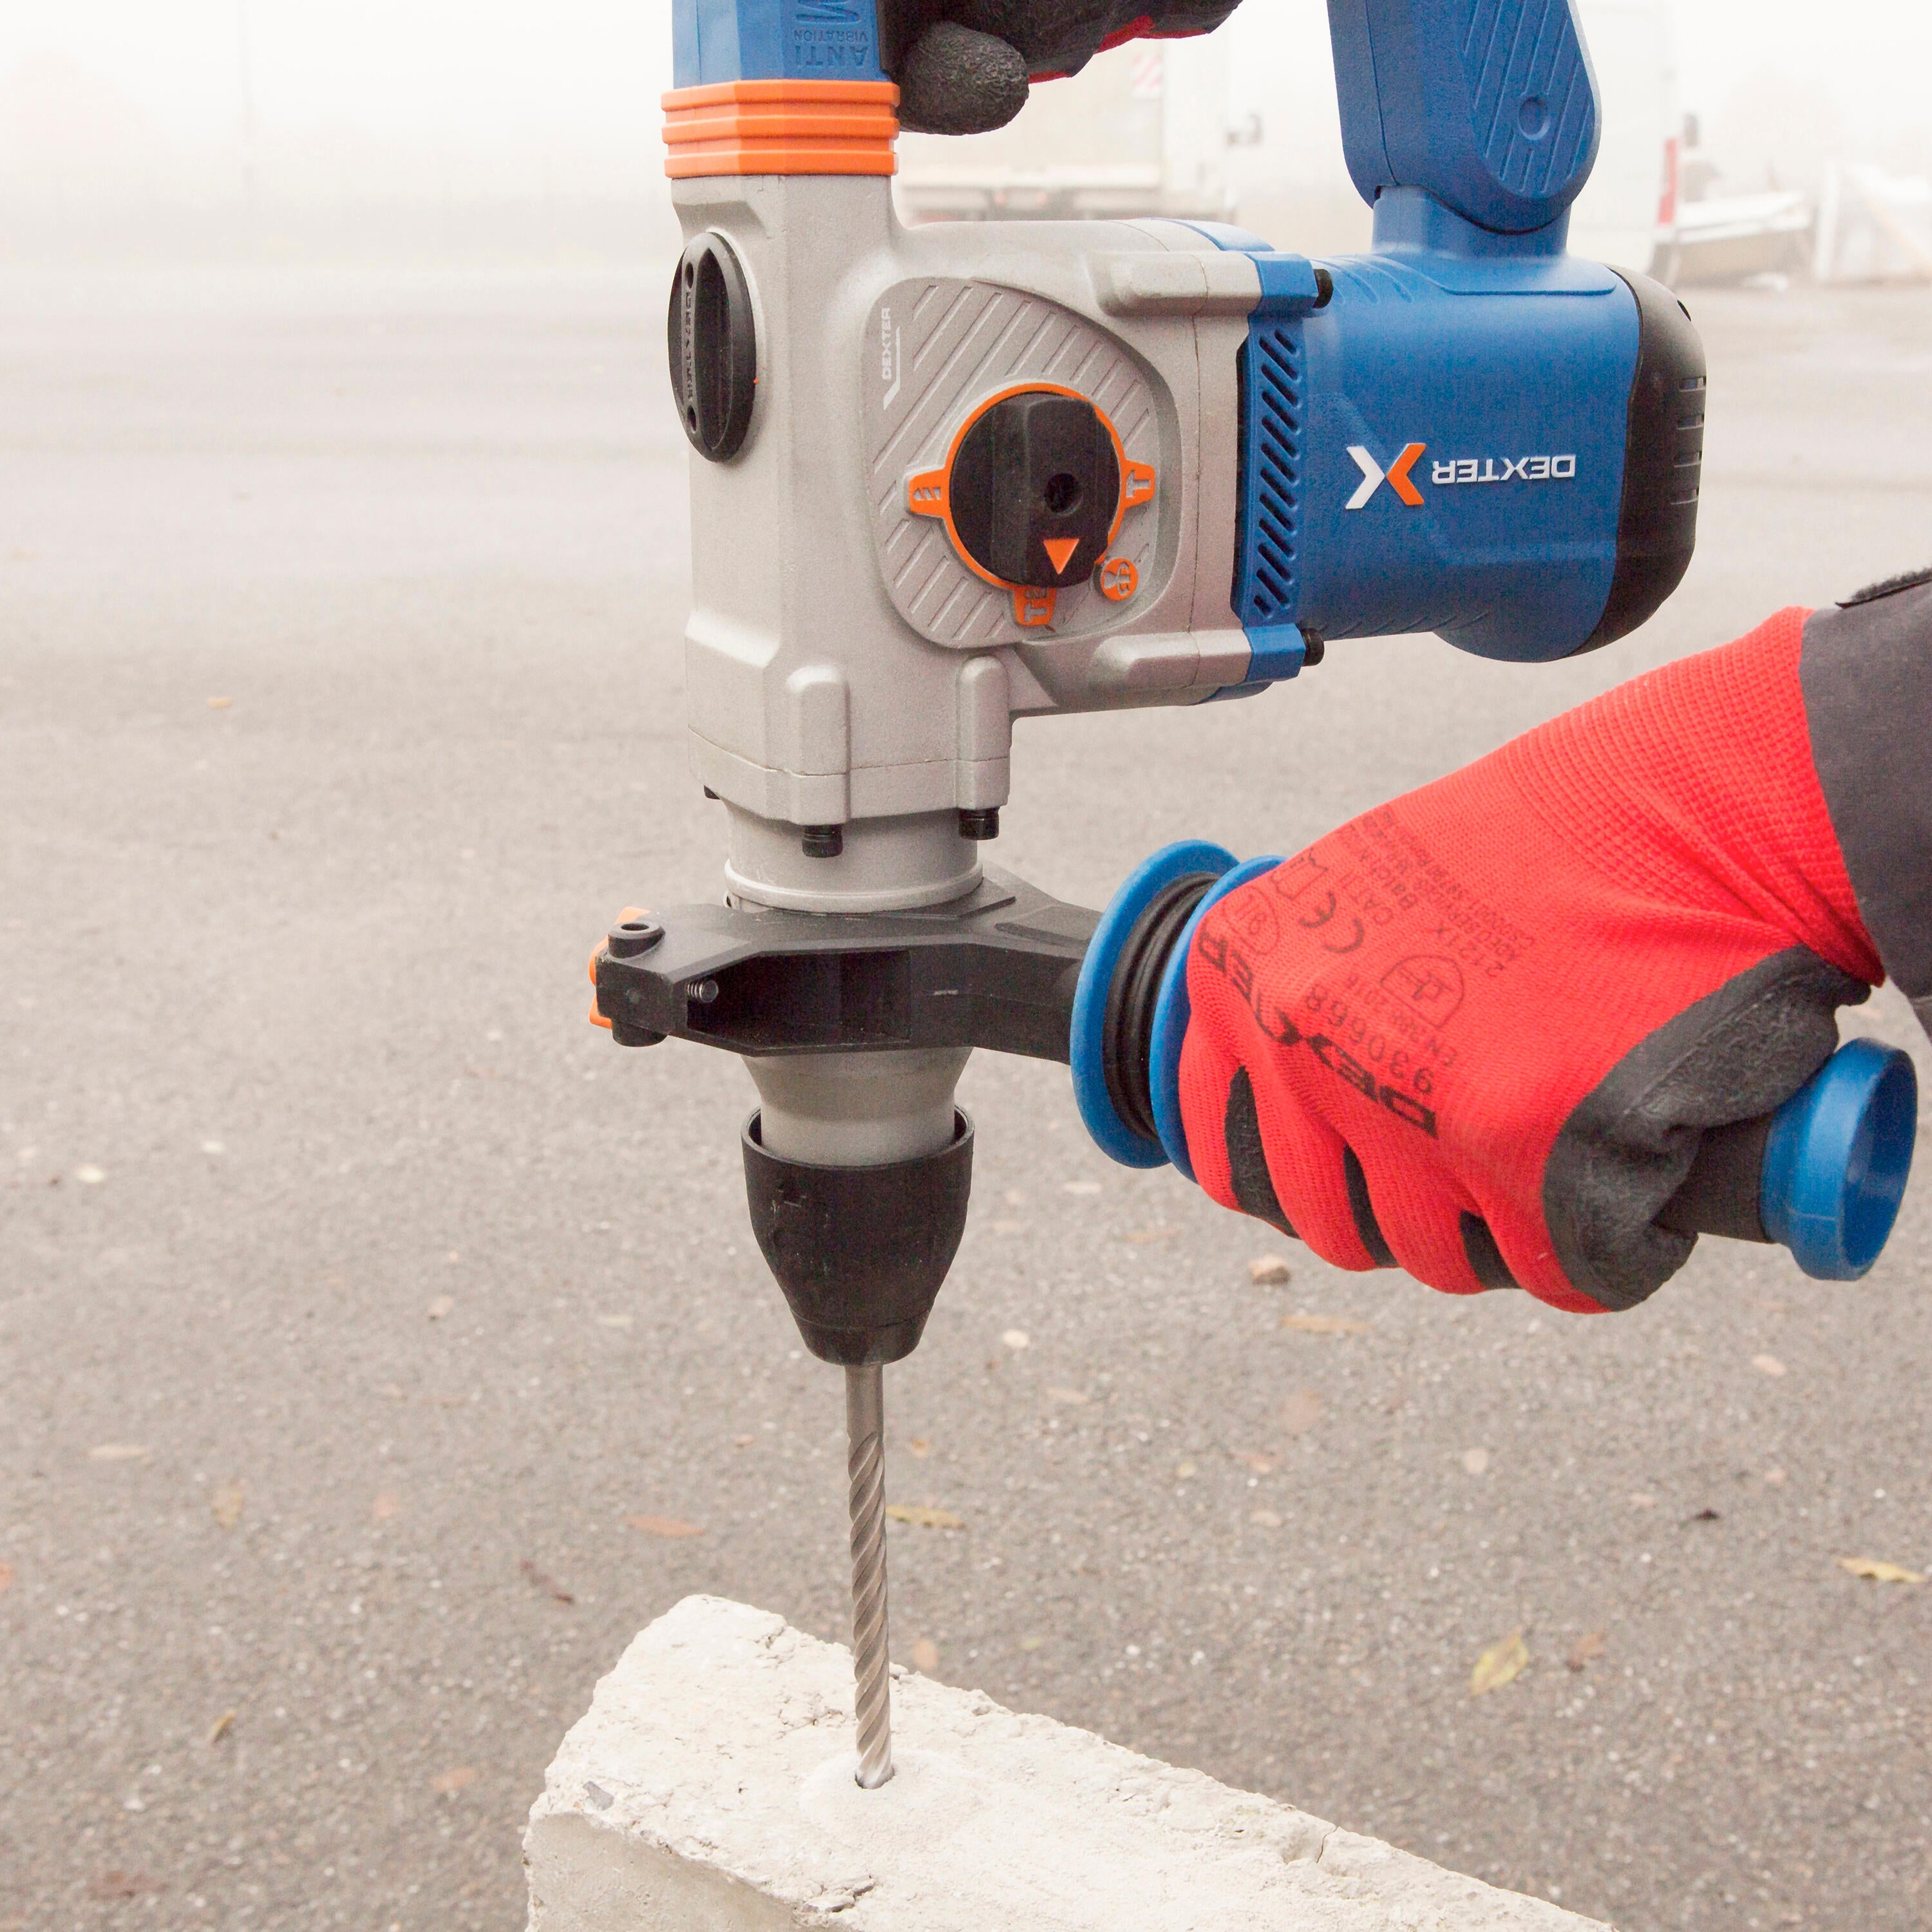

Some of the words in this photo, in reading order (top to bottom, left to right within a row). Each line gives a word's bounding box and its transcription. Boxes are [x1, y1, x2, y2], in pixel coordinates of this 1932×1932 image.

[793, 30, 869, 43] VIBRATION
[794, 44, 869, 68] ANTI
[882, 307, 892, 380] DEXTER
[1432, 454, 1576, 484] DEXTER
[1350, 887, 1394, 929] CAT
[1305, 983, 1434, 1095] 930668
